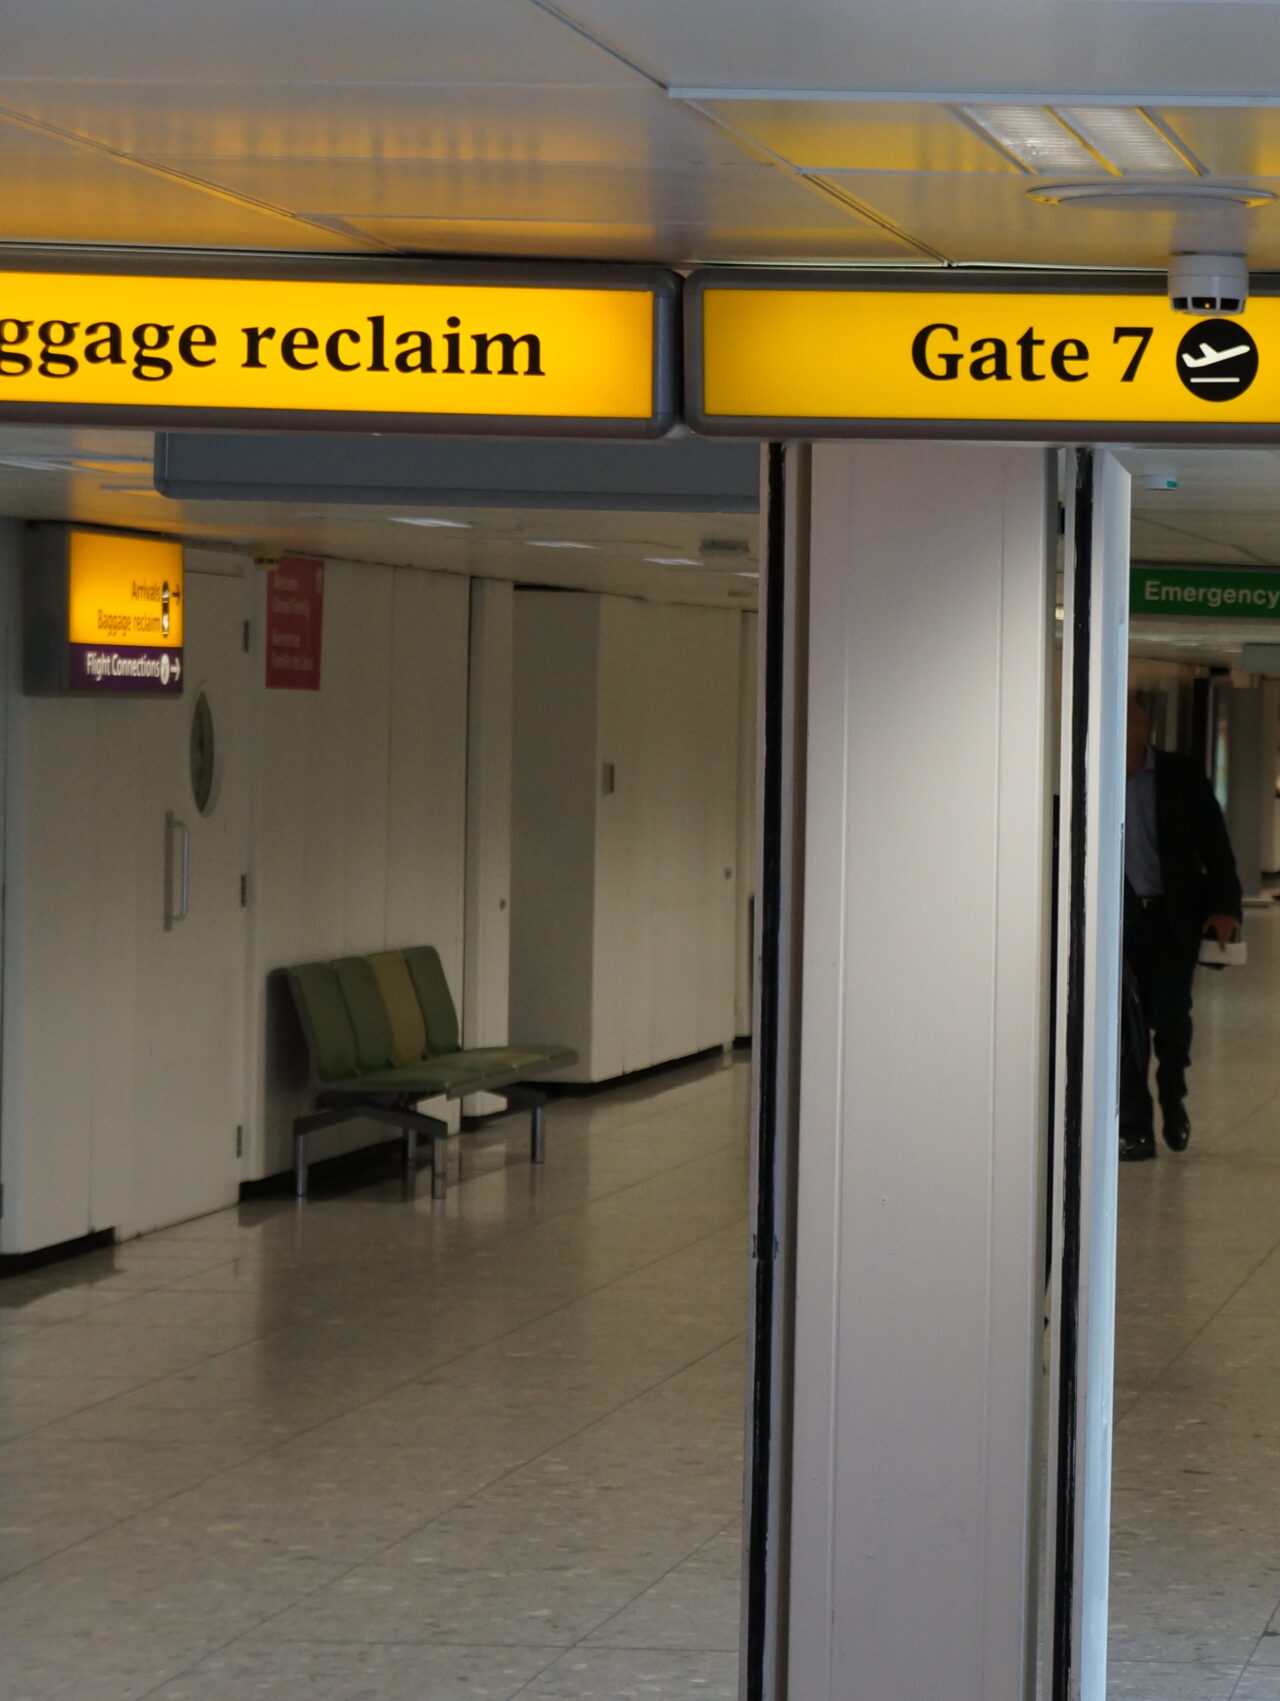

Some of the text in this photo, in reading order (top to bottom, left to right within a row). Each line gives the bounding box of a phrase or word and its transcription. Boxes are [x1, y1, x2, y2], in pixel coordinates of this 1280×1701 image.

[0, 314, 546, 382] ggage reclaim
[911, 322, 1154, 383] Gate 7
[131, 580, 161, 603] Arrivals
[1144, 581, 1280, 609] Emergency
[97, 609, 131, 637] Baggage
[86, 652, 160, 682] Flight Connections
